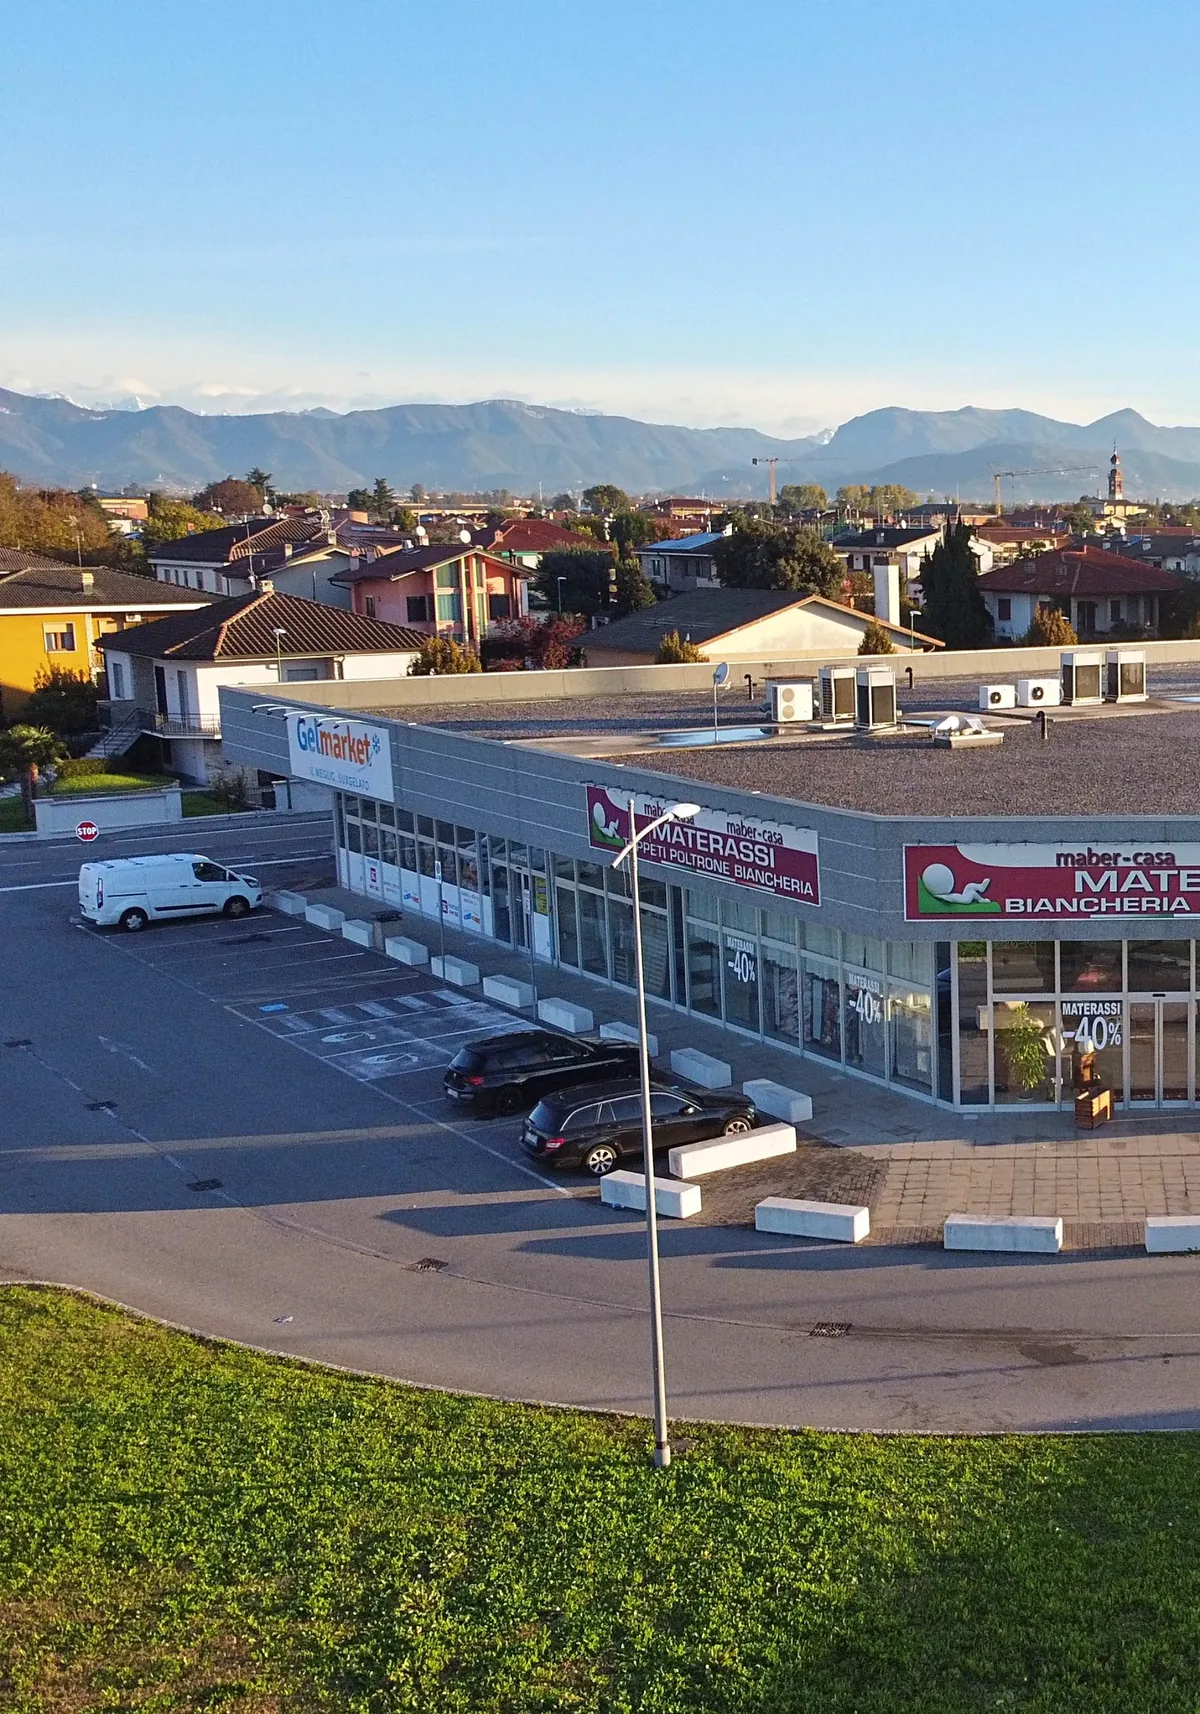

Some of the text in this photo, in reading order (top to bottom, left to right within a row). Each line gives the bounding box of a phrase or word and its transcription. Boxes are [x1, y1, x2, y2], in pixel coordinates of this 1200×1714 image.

[296, 717, 370, 766] Gelmarket
[644, 801, 695, 826] mabasa
[77, 827, 97, 836] STOP
[726, 819, 784, 846] maber-casa
[652, 822, 776, 868] MATERASSI
[1055, 847, 1176, 867] maber-casa
[623, 837, 814, 897] TPPETI POLTRONE BIANCHERIA
[1005, 896, 1190, 913] BIANCHERIA
[727, 935, 755, 953] MATERASSI
[727, 951, 756, 983] -40%
[848, 972, 880, 994] MATERASSI
[848, 989, 881, 1024] -40%
[1062, 1002, 1121, 1016] MATERASSI
[1062, 1016, 1122, 1050] -40%
